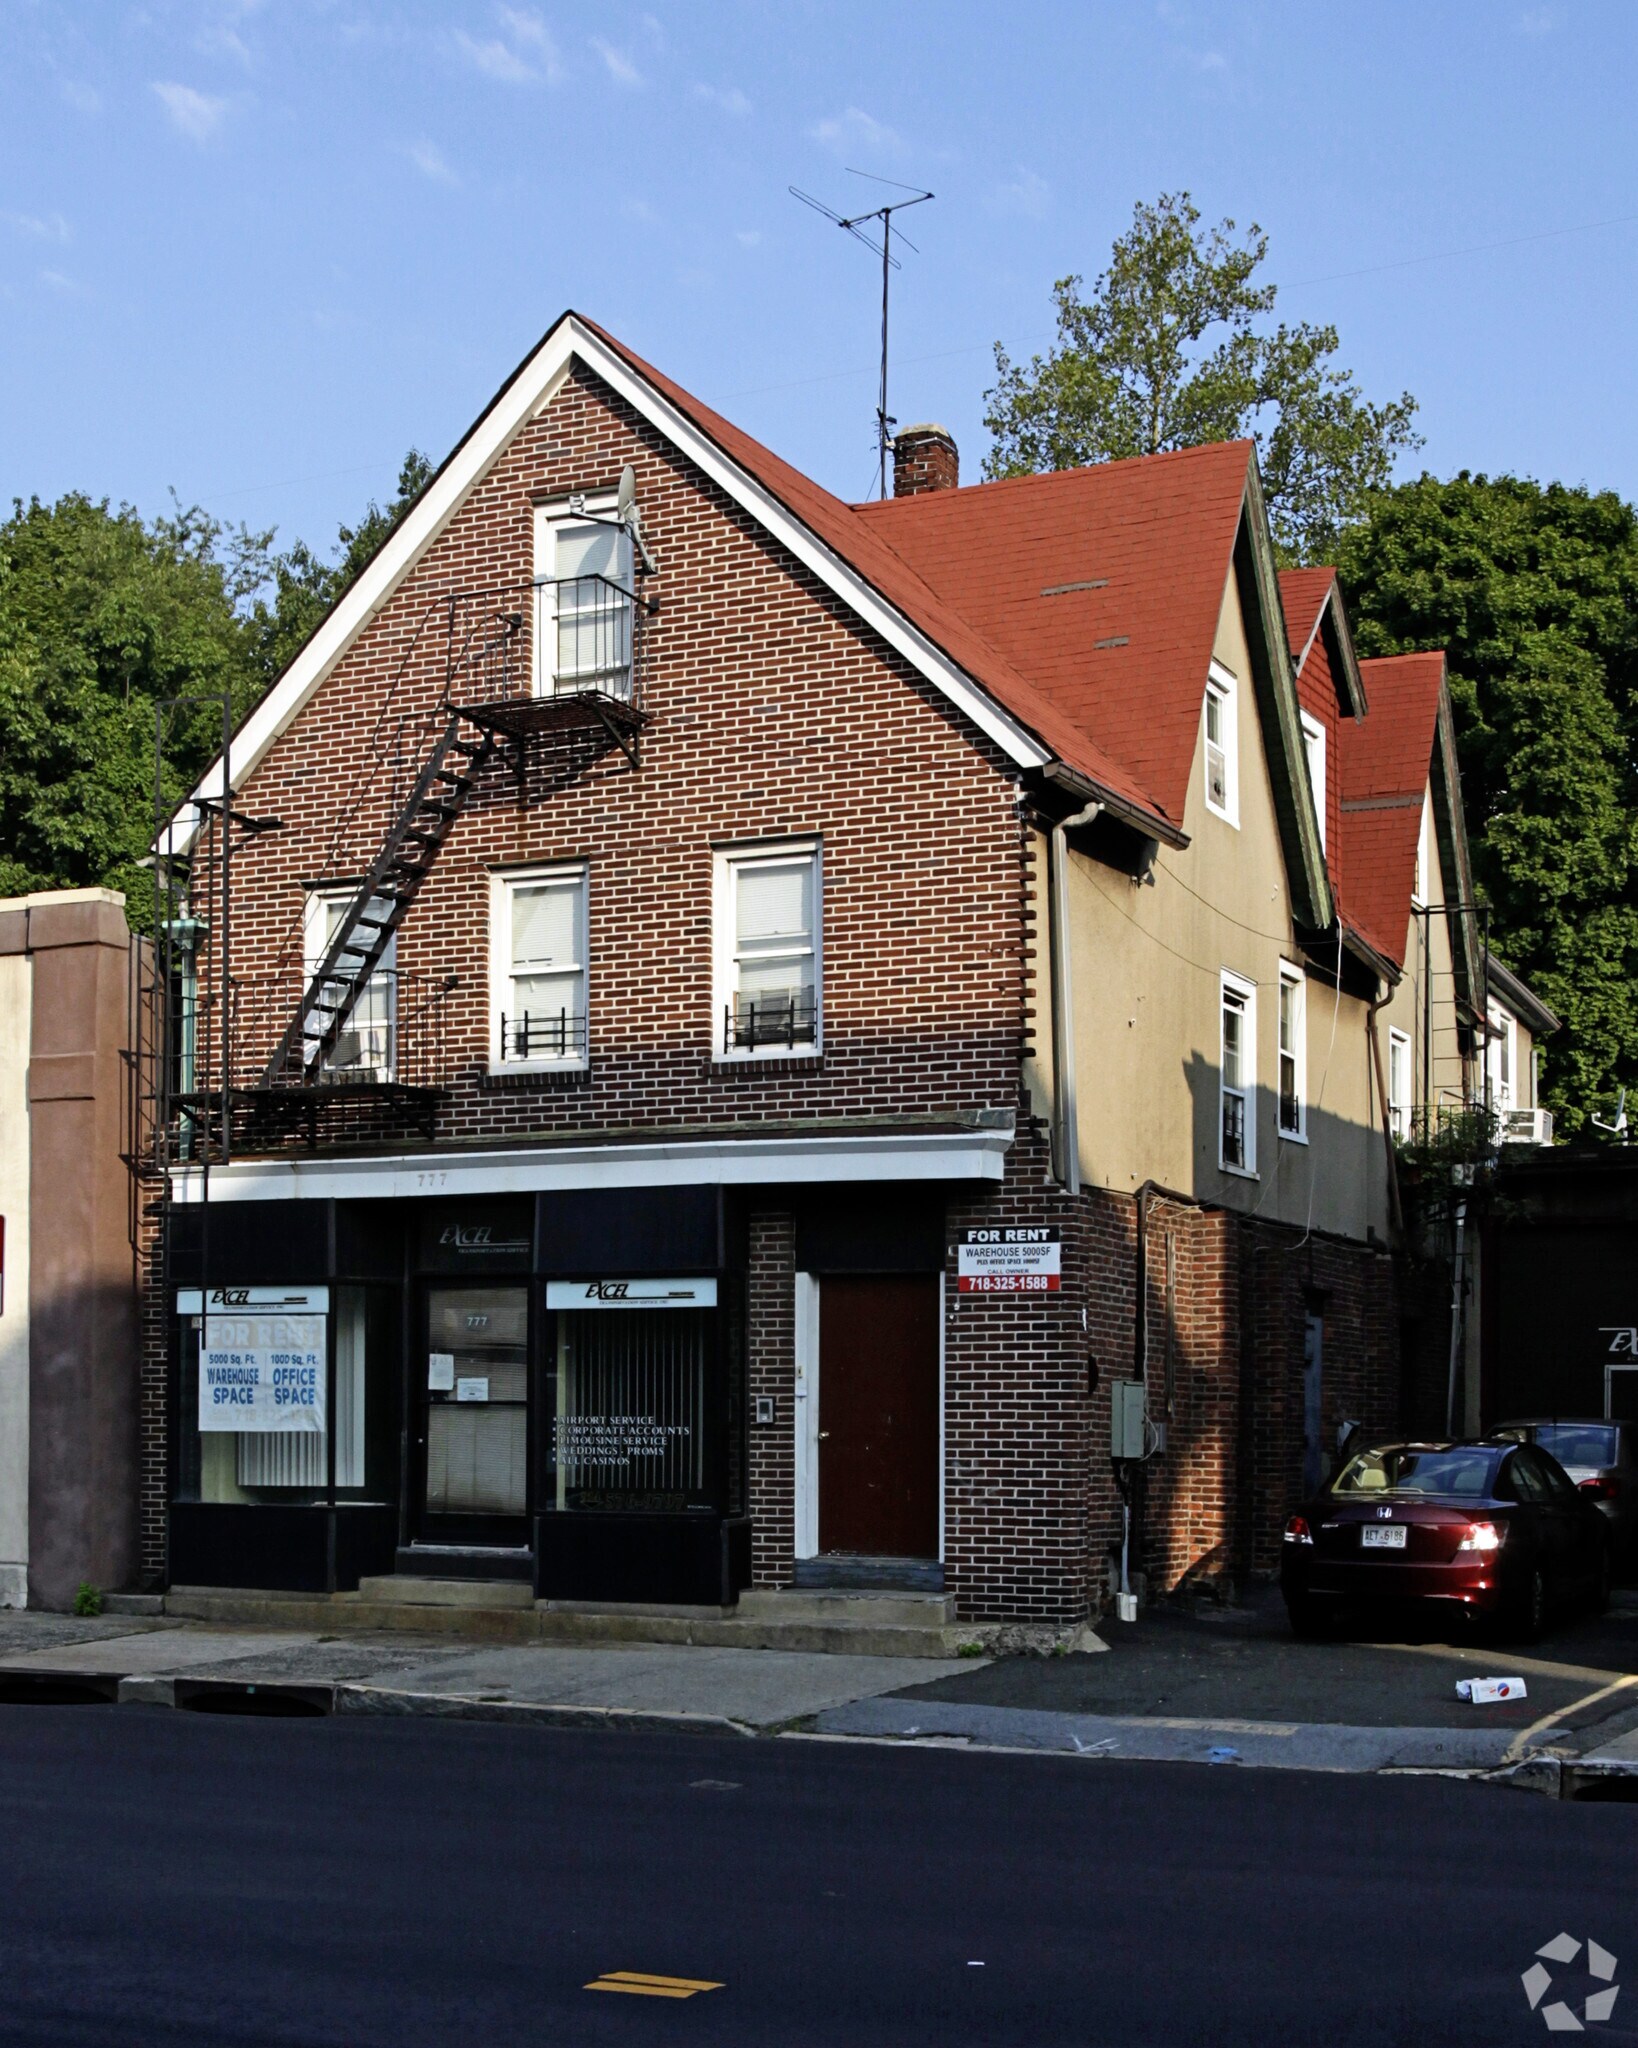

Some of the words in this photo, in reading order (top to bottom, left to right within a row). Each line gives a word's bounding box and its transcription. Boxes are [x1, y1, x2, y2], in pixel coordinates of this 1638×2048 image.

[417, 1172, 447, 1186] 777
[440, 1225, 492, 1245] EXCEL
[967, 1230, 1001, 1242] FOR
[1005, 1228, 1050, 1241] RENT
[965, 1247, 1020, 1257] WAREHOUSE
[1022, 1246, 1051, 1256] 5000SF
[585, 1281, 629, 1299] EXCEL
[968, 1276, 1048, 1290] 718-325-1588
[211, 1288, 250, 1305] EXCEL
[467, 1317, 488, 1326] 777
[208, 1322, 249, 1346] FOR
[258, 1322, 318, 1346] RENT
[209, 1354, 228, 1364] 5000
[230, 1354, 243, 1366] Sq.
[245, 1354, 257, 1364] Ft.
[271, 1354, 290, 1364] 1000
[291, 1354, 304, 1366] Sq.
[306, 1354, 319, 1365] Ft.
[207, 1368, 259, 1385] WAREHOUSE
[272, 1368, 316, 1385] OFFICE
[213, 1387, 254, 1404] SPACE
[274, 1387, 315, 1405] SPACE
[559, 1416, 607, 1424] AIRPORT
[610, 1416, 654, 1424] SERVICE
[559, 1426, 625, 1435] CORPORATE
[629, 1426, 690, 1435] ACCOUNTS
[623, 1436, 668, 1445] SERVICE
[559, 1446, 618, 1455] WEDDINGS
[627, 1447, 665, 1455] PROMS
[559, 1457, 580, 1465] ALL
[583, 1457, 630, 1465] CASINOS
